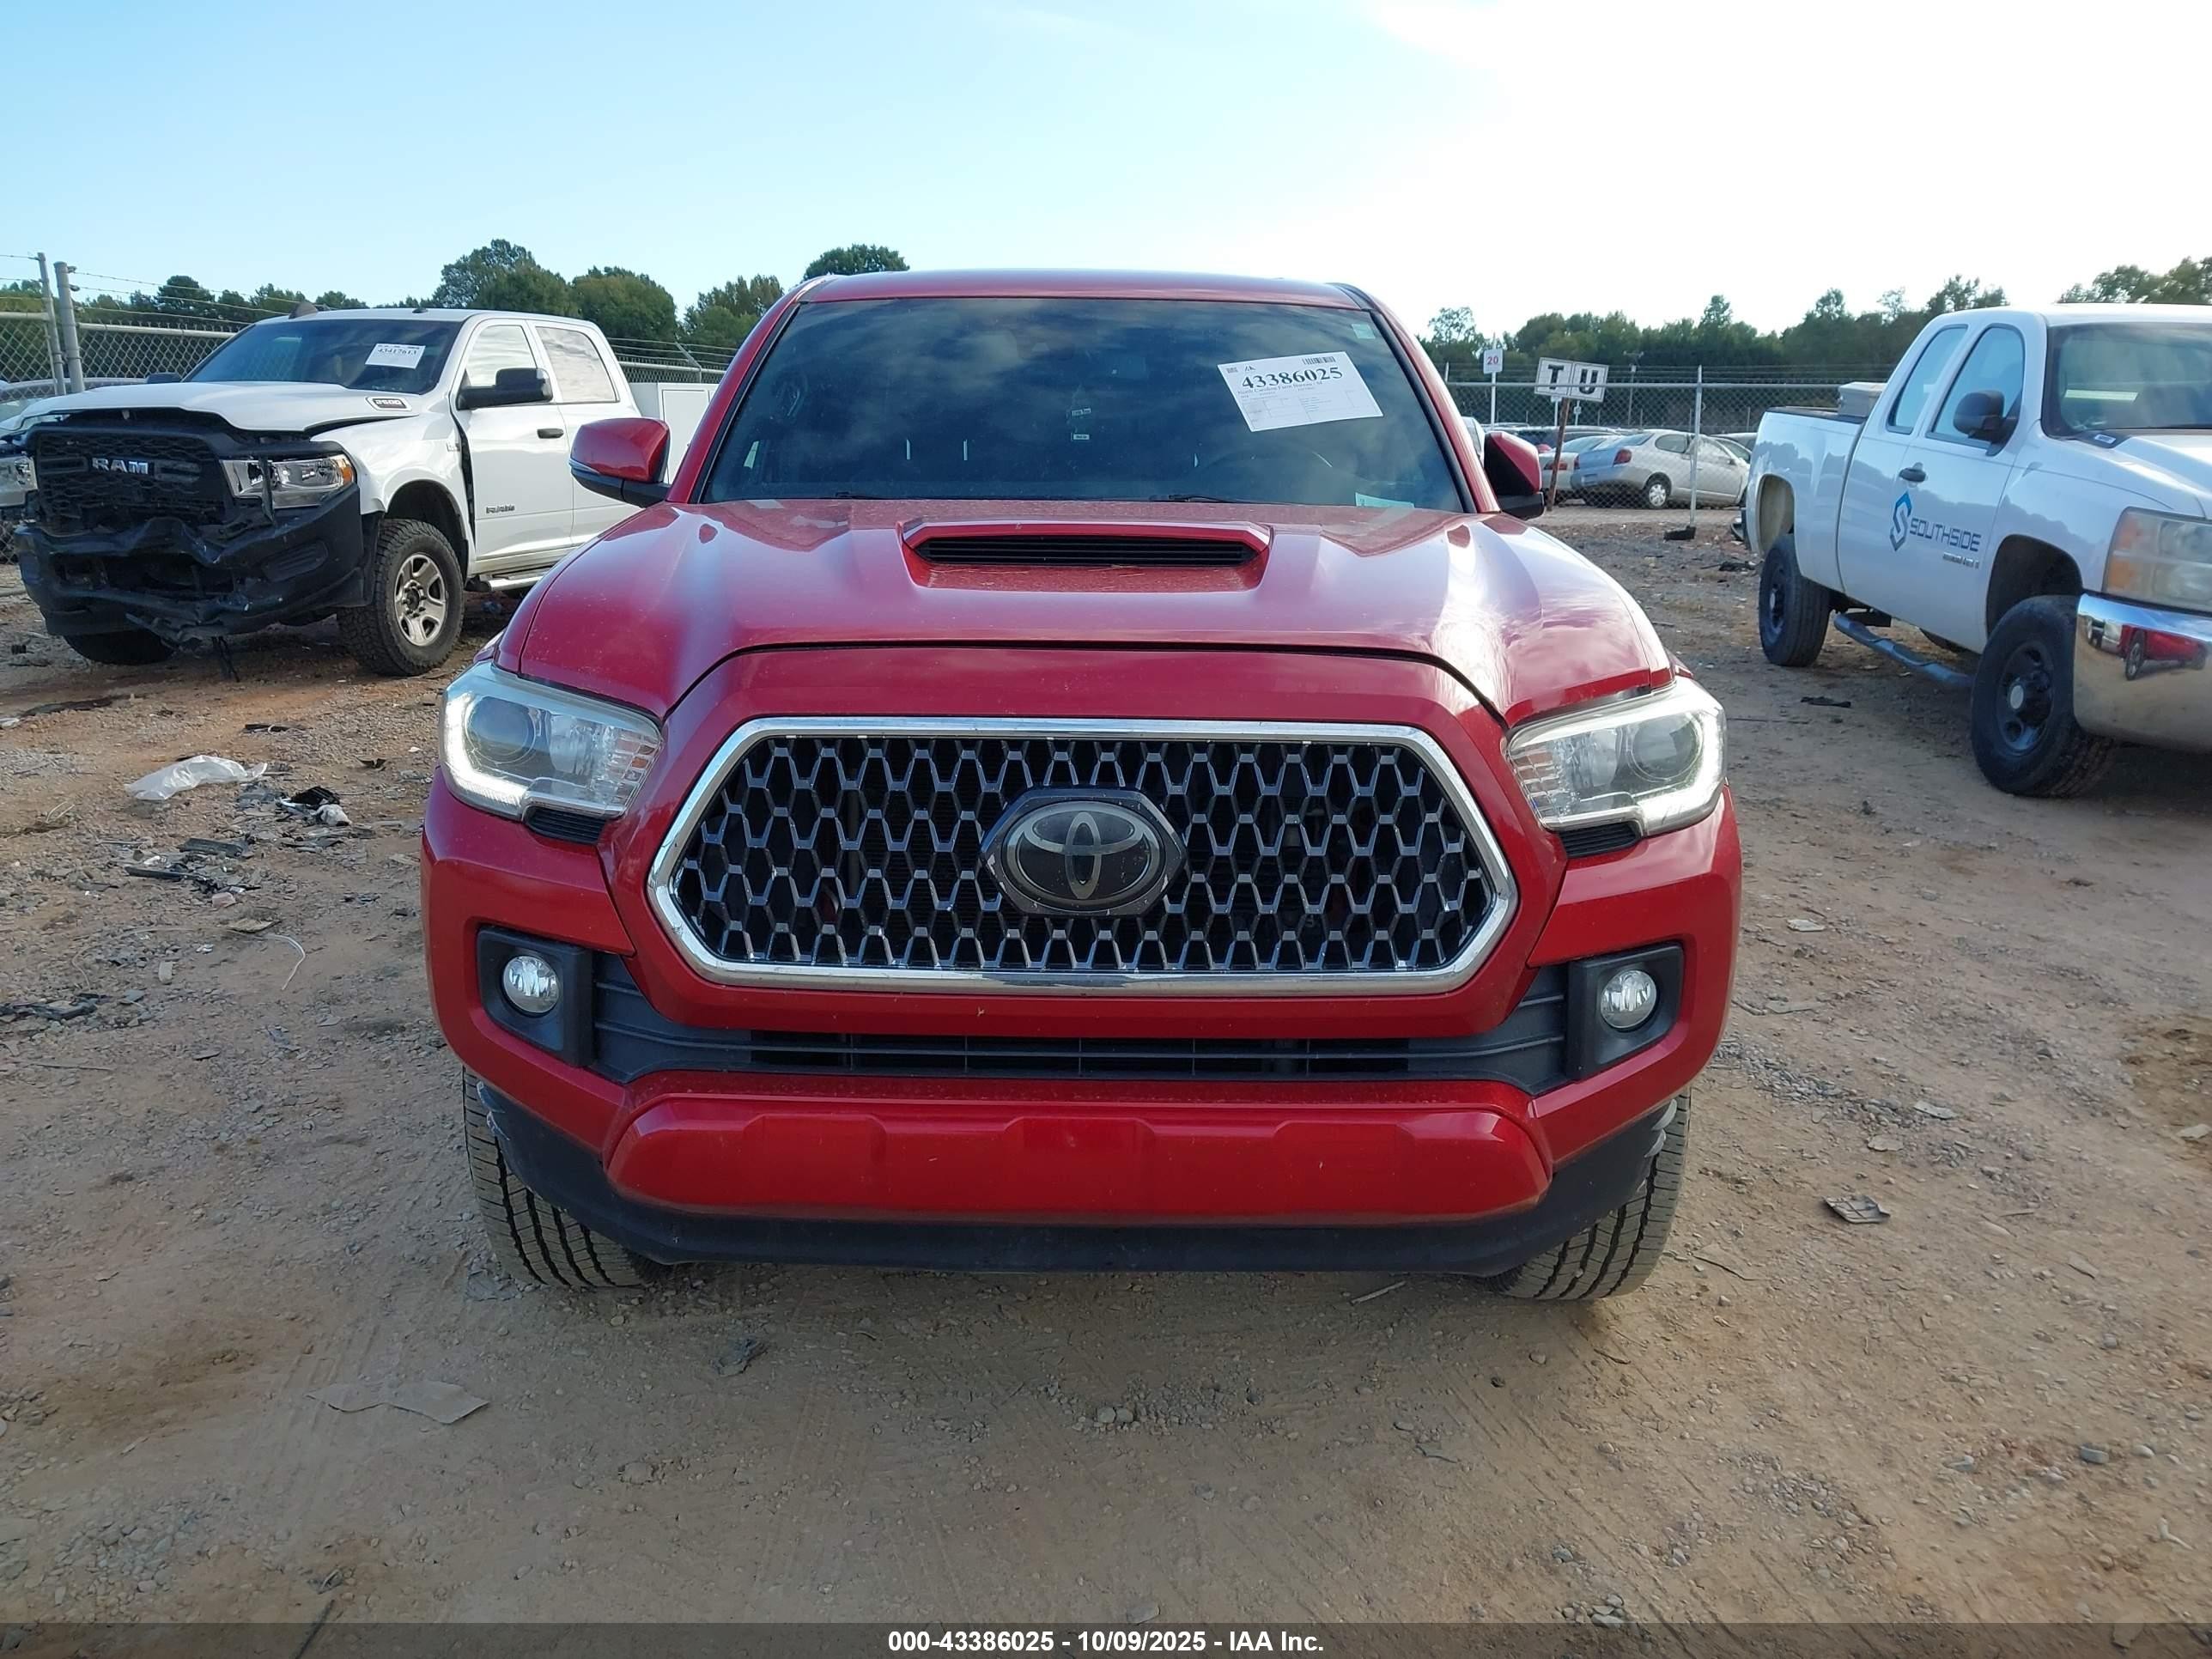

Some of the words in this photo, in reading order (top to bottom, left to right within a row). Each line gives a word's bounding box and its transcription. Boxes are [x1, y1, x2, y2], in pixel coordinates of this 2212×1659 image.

[1487, 356, 1499, 366] 20
[1242, 367, 1343, 389] 43386025
[1548, 364, 1565, 390] T
[1579, 368, 1599, 394] U
[92, 457, 149, 475] RAM
[1910, 517, 1982, 552] SOUTHSIDE
